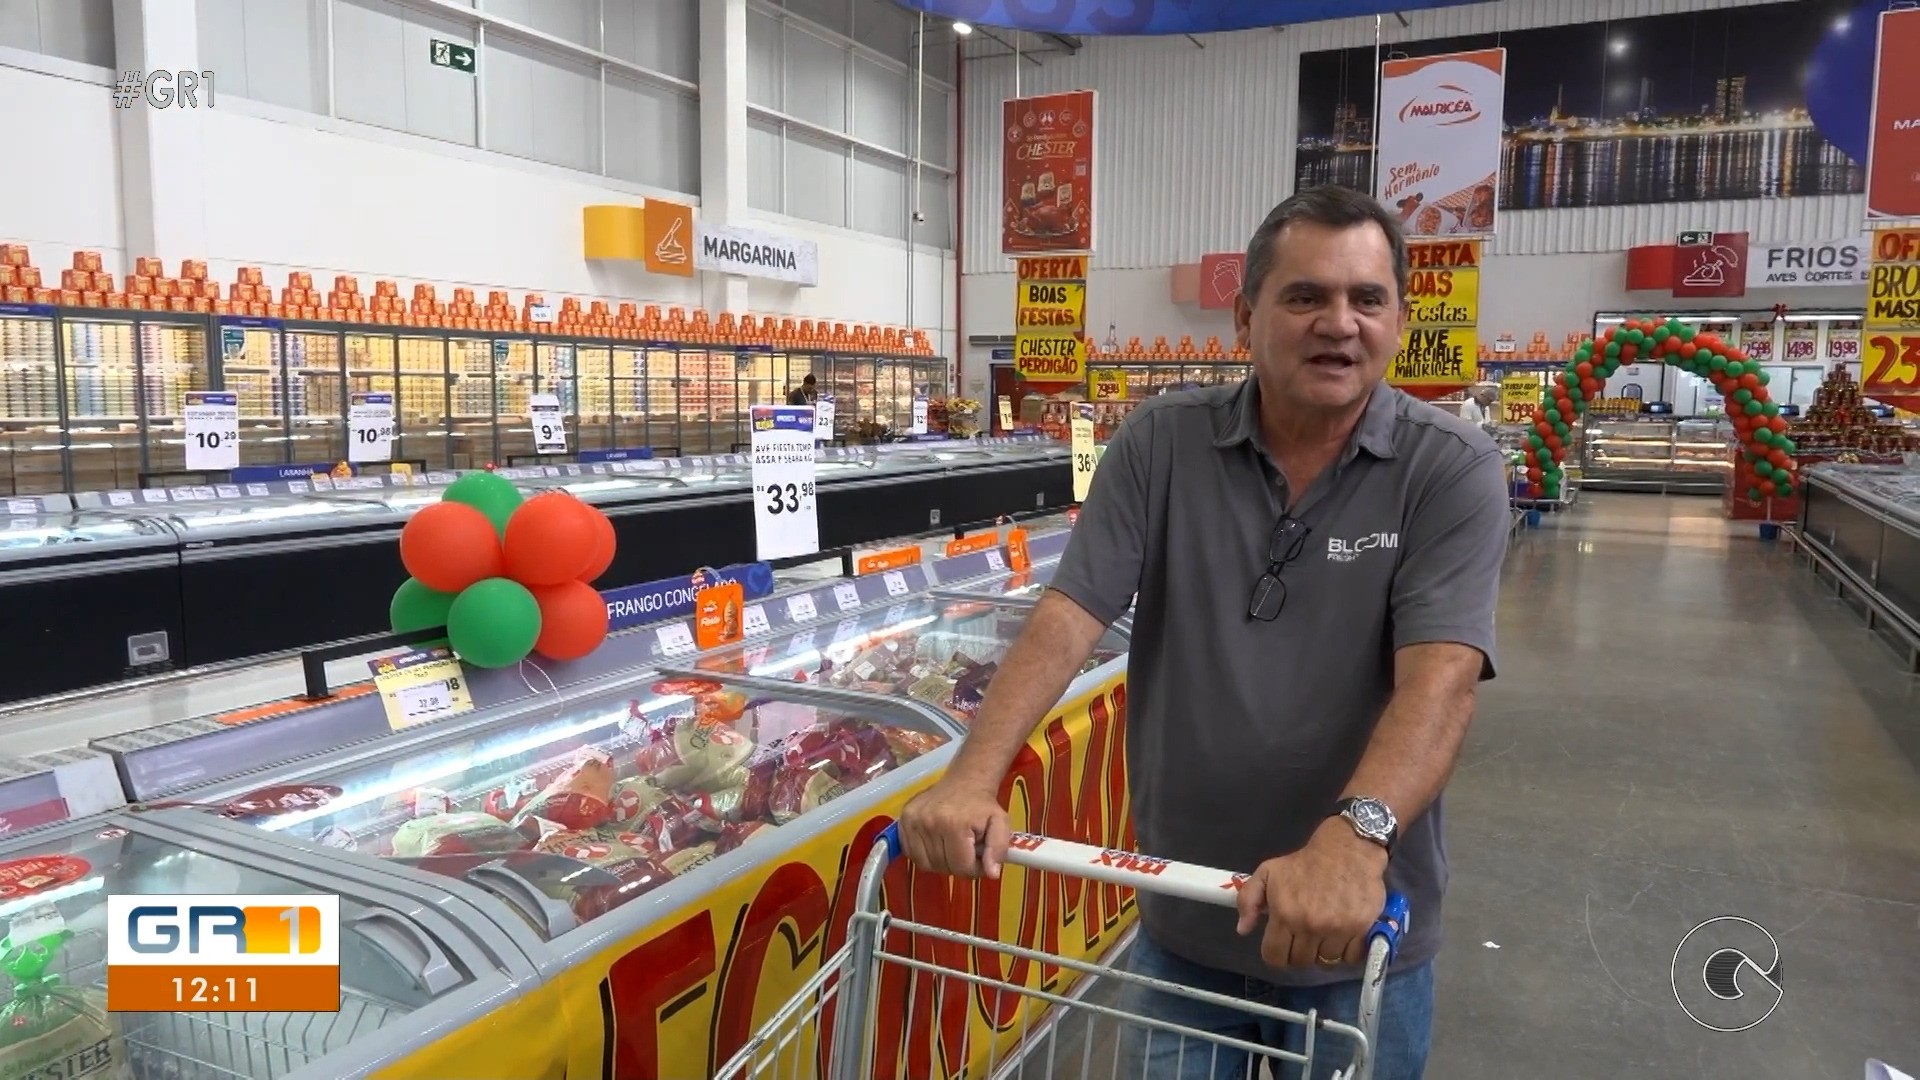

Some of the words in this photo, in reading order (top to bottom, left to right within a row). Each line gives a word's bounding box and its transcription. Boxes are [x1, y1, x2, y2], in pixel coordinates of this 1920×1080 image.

[1389, 162, 1417, 182] Sem
[703, 236, 797, 271] MARGARINA
[1767, 245, 1858, 269] FRIOS
[1018, 257, 1083, 280] OFERTA
[1766, 272, 1797, 282] AVES
[1805, 270, 1853, 282] CORTES
[1407, 270, 1454, 298] OAS
[1028, 285, 1067, 305] BOAS
[1018, 307, 1076, 328] FESTAS
[1020, 338, 1077, 357] CHESTER
[1408, 329, 1450, 349] AVE
[1018, 355, 1078, 376] PERDIGÃO
[606, 592, 663, 620] FRANGO
